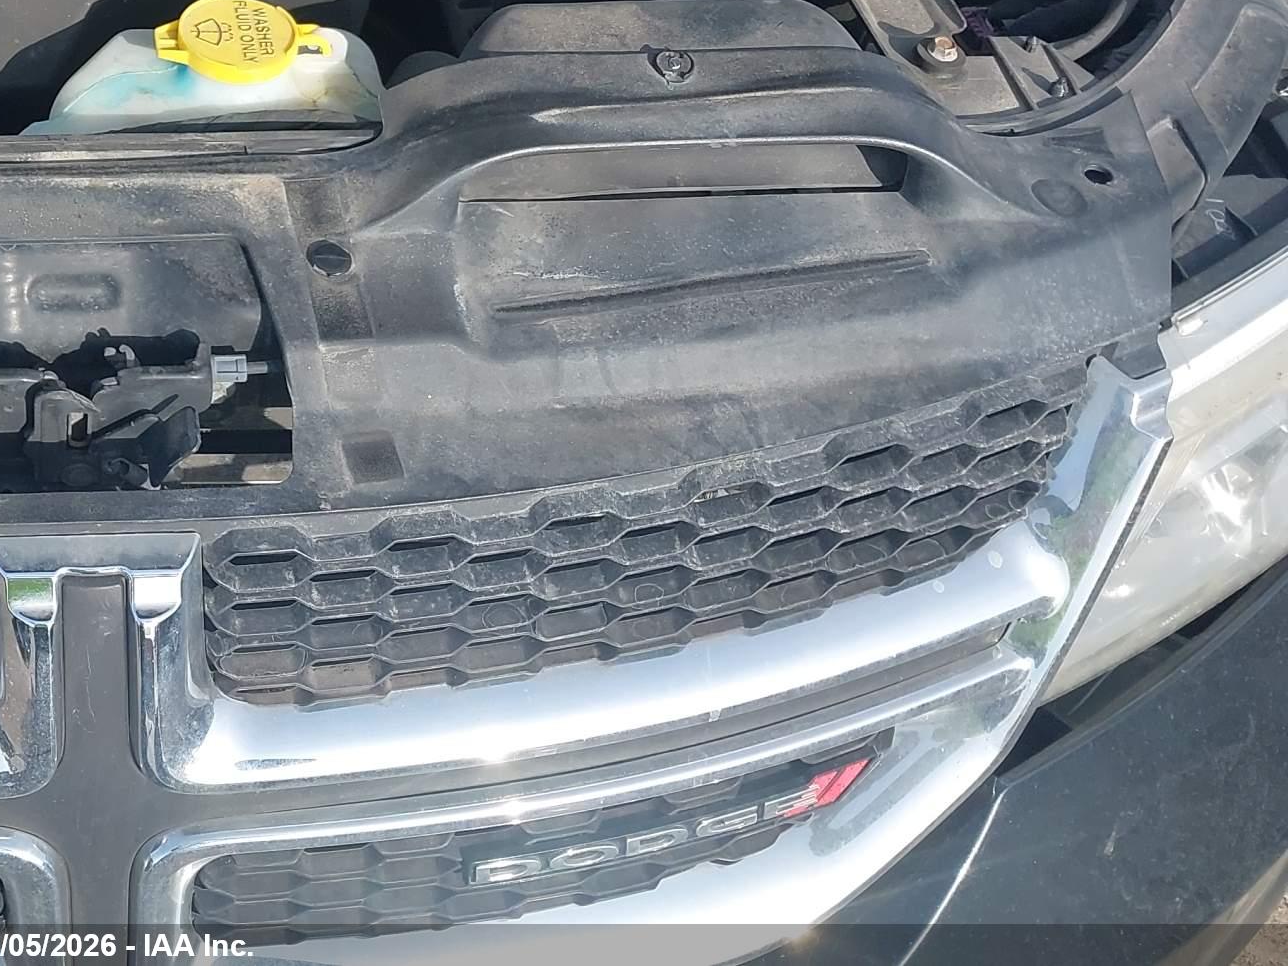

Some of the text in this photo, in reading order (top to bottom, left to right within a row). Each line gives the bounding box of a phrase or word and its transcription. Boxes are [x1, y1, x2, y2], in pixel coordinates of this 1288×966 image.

[232, 0, 260, 64] FLUID ONLY
[252, 7, 275, 56] WASHER
[469, 784, 820, 886] DODGE
